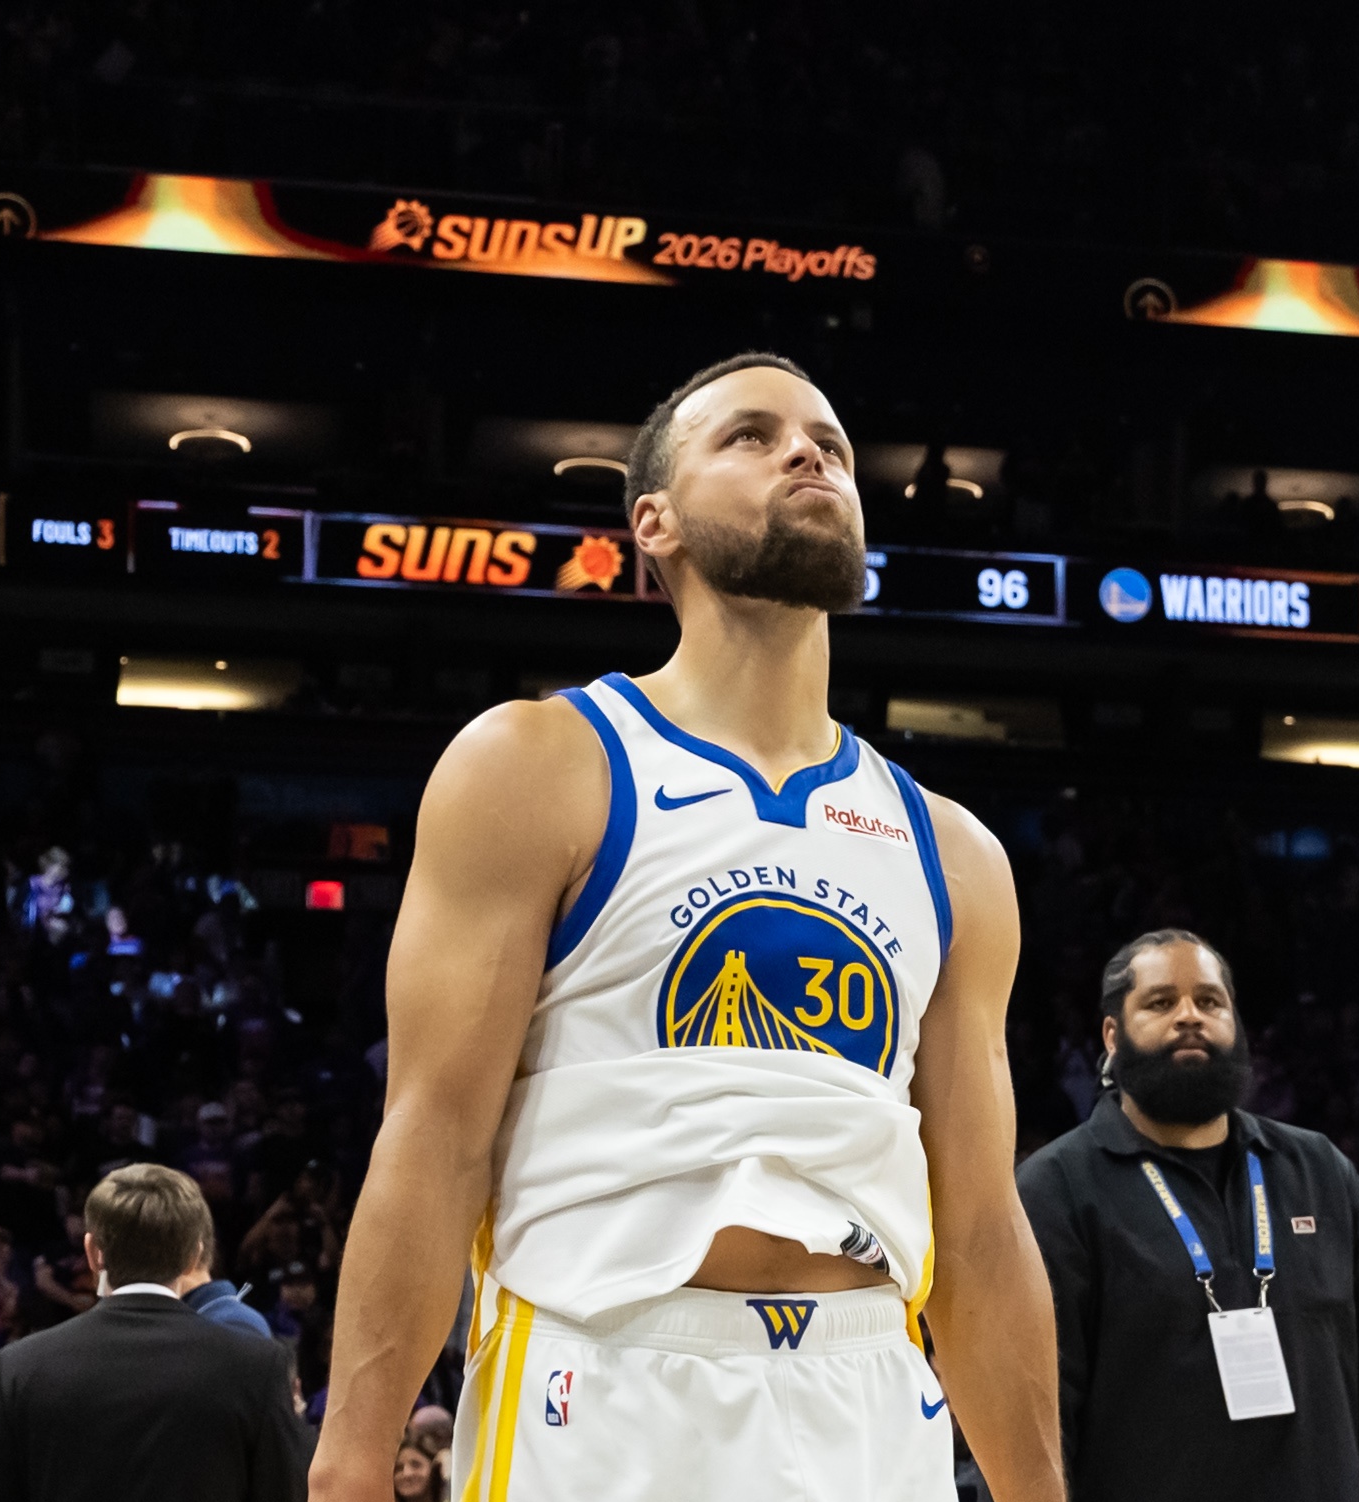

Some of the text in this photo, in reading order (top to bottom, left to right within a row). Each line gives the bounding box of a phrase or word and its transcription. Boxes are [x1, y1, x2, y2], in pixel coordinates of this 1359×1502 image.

[652, 232, 741, 271] 2026
[742, 238, 877, 282] Playoffs
[32, 518, 116, 550] FOULS 3
[168, 526, 281, 560] TIMEOUTS 2
[357, 523, 537, 586] SUNS
[977, 568, 1030, 610] 96
[1158, 573, 1310, 629] WARRIORS
[823, 803, 910, 843] Rakuten
[670, 866, 903, 959] GOLDEN STATE
[794, 956, 875, 1032] 30
